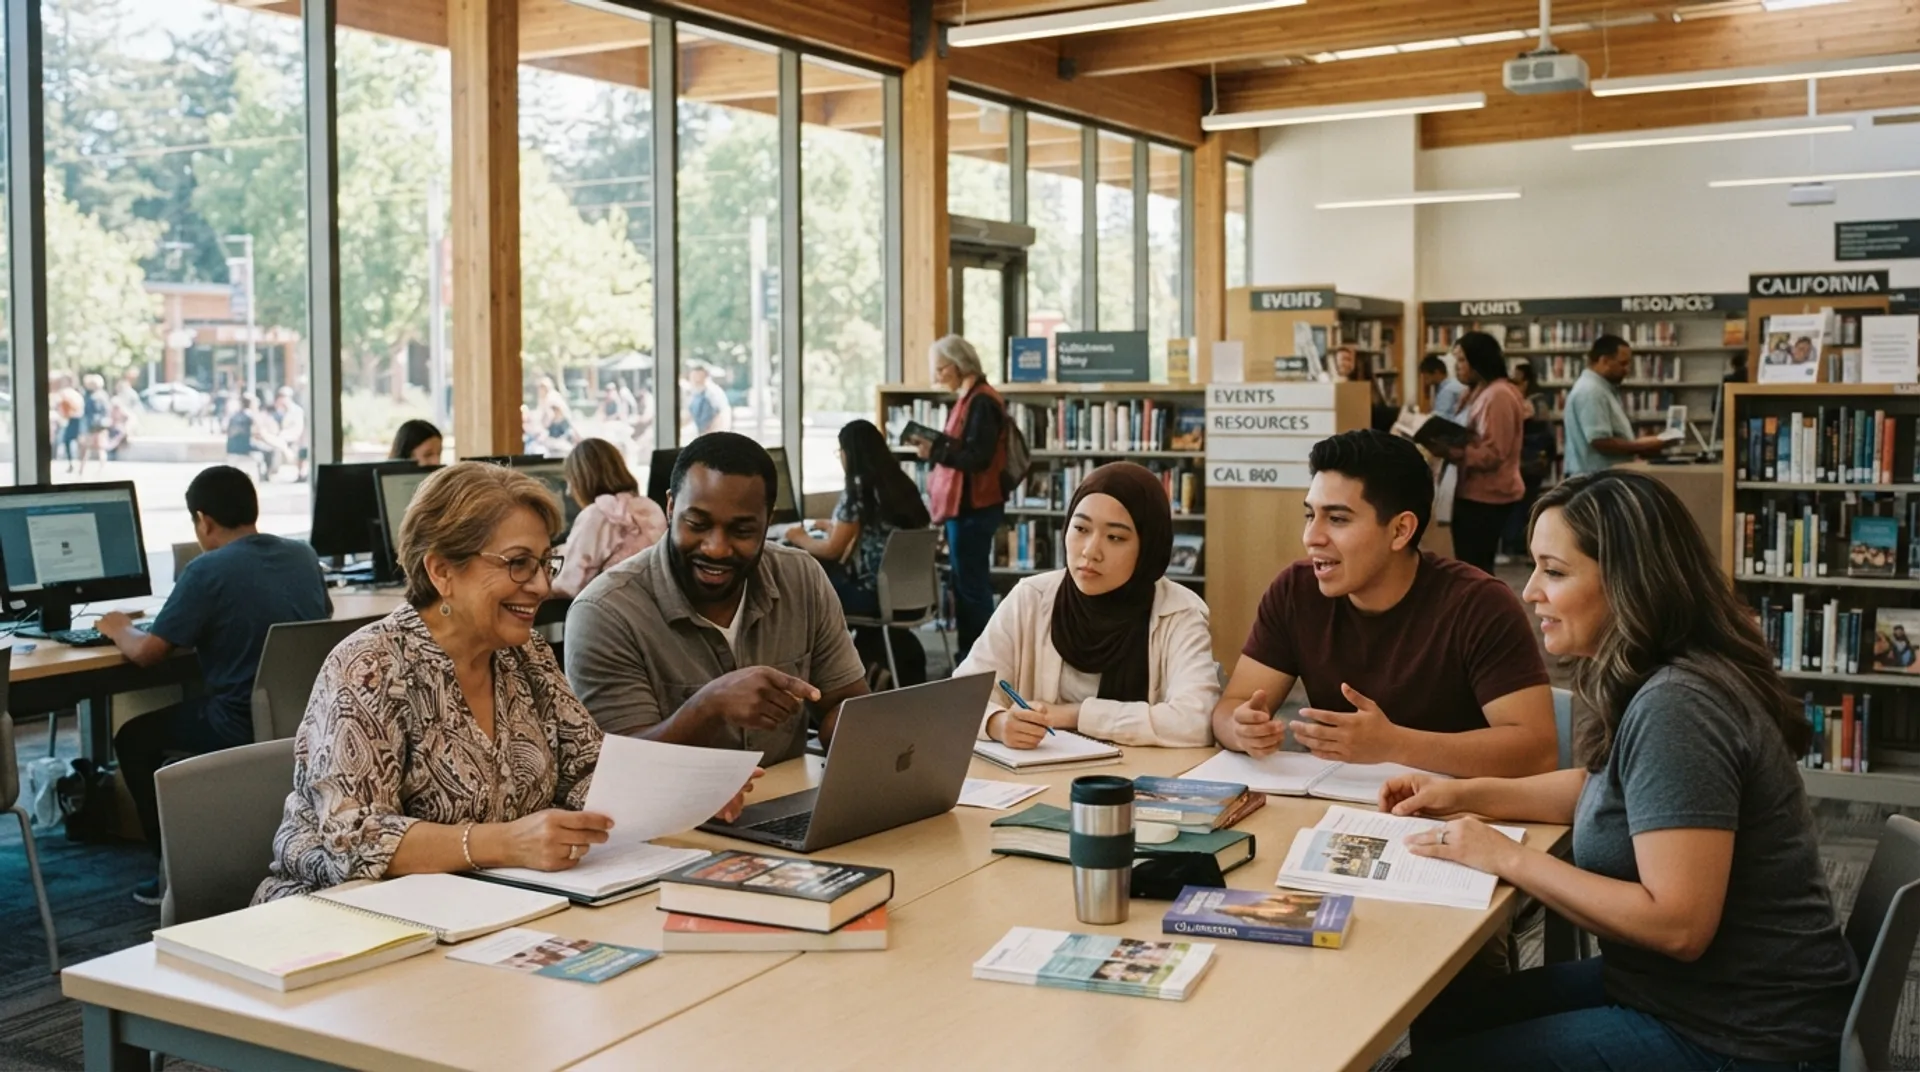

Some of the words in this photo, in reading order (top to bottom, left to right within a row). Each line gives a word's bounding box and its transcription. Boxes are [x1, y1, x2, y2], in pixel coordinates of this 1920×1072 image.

[1756, 275, 1880, 295] CALIFORNIA
[1214, 389, 1275, 403] EVENTS
[1214, 415, 1310, 430] RESOURCES
[1213, 467, 1245, 483] CAL
